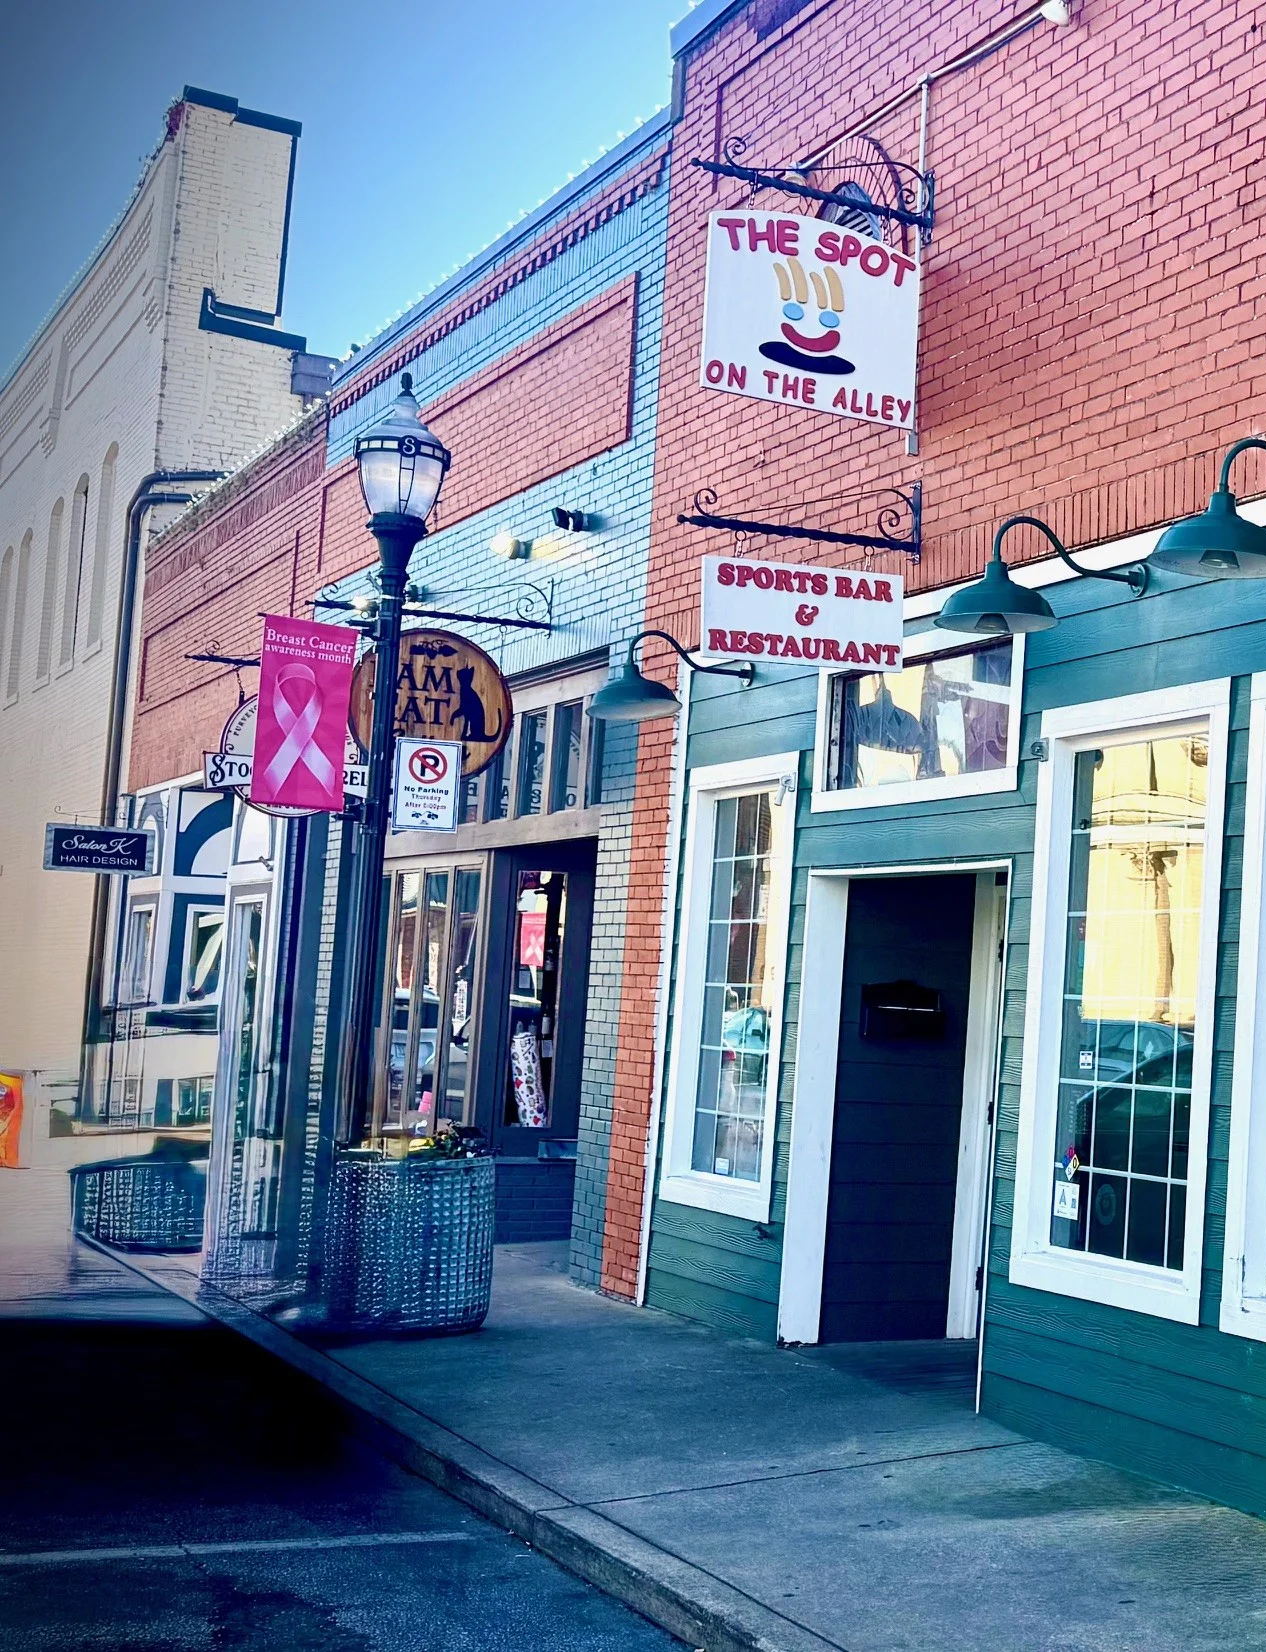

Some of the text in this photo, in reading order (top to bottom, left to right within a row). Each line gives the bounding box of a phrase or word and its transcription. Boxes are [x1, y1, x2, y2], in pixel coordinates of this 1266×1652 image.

[717, 217, 916, 287] THE SPOT
[705, 359, 912, 423] ON THE ALLEY
[717, 562, 893, 603] SPORTS BAR
[794, 604, 819, 626] &
[264, 643, 351, 664] awareness month
[266, 628, 354, 654] Breast Cancer
[708, 628, 901, 666] RESTAURANT
[395, 662, 456, 694] AM
[394, 695, 452, 726] AT
[209, 754, 253, 786] STO
[412, 794, 441, 802] Thursday
[418, 787, 449, 795] Parking
[62, 834, 139, 855] Salon K
[60, 854, 138, 866] HAIR DESIGN
